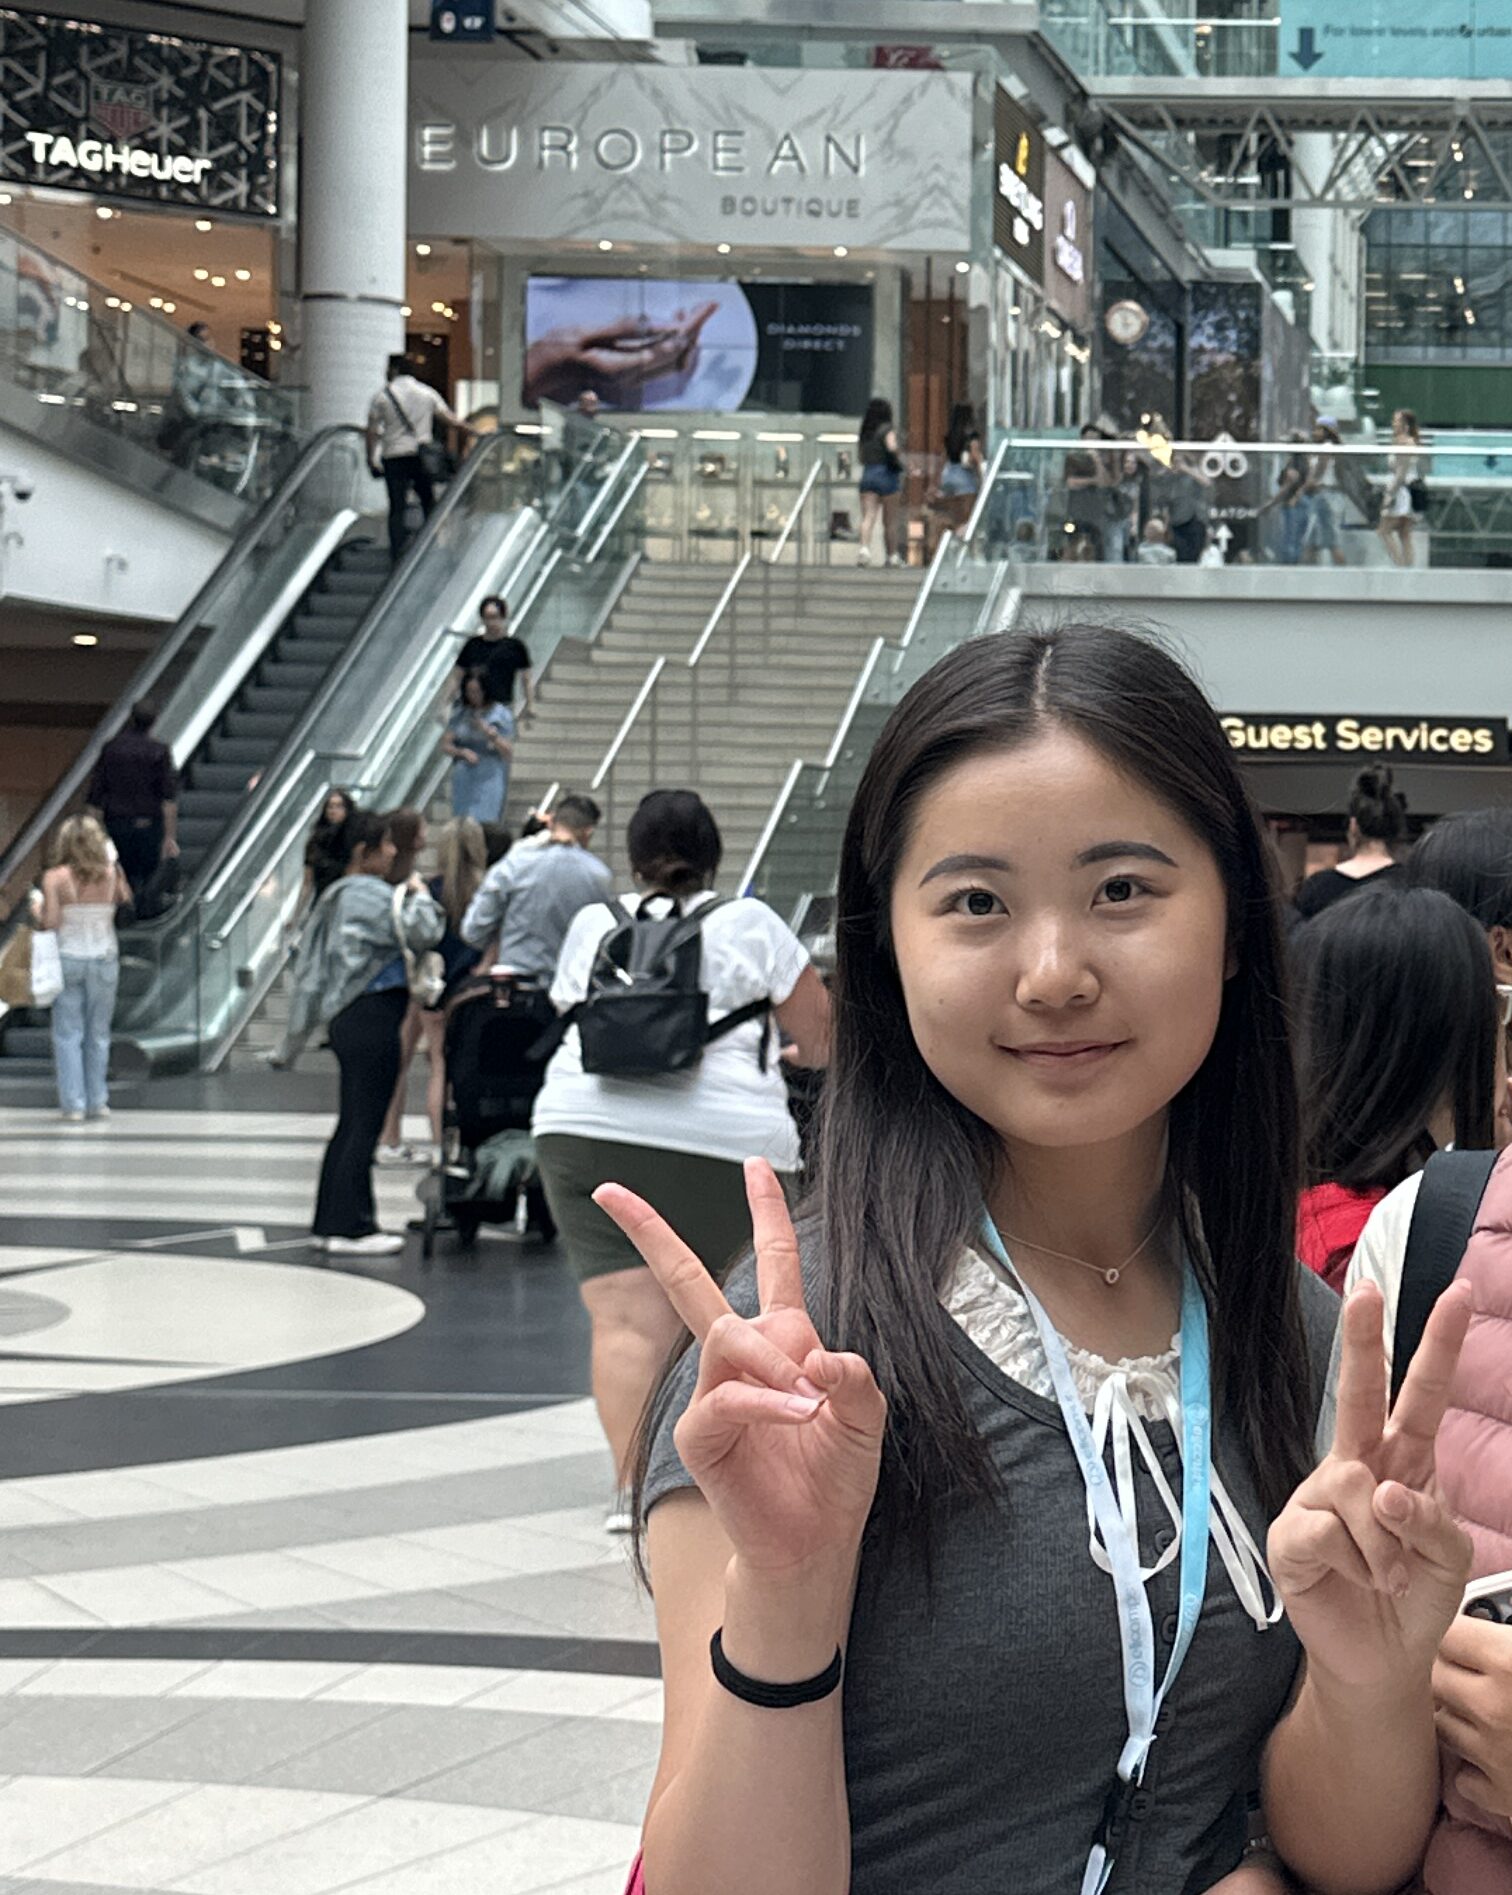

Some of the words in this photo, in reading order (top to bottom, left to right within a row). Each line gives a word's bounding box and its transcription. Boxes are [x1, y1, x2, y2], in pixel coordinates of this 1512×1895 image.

[417, 122, 868, 178] EUROPEAN
[720, 194, 861, 219] BOUTIQUE
[765, 322, 863, 338] DIAMONDS
[781, 337, 847, 353] DIRECT
[1219, 716, 1328, 750] Guest
[1335, 718, 1494, 753] Services
